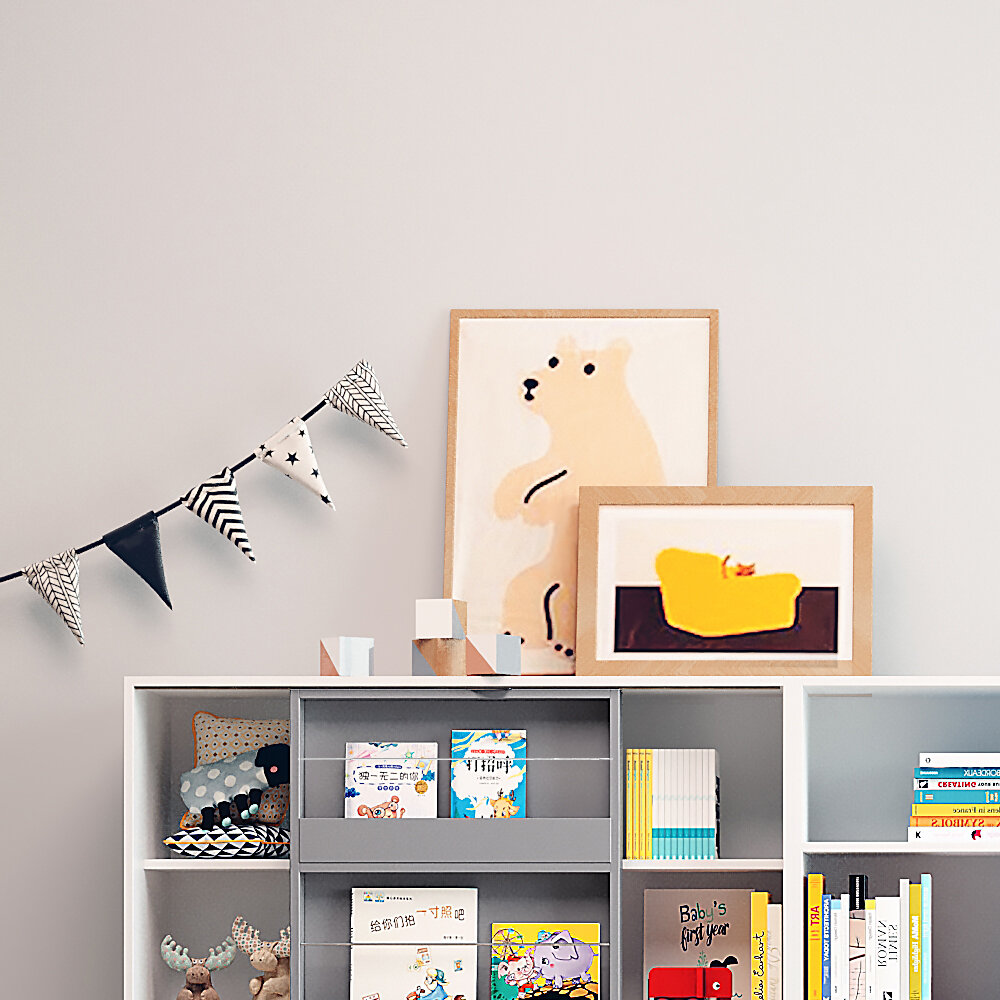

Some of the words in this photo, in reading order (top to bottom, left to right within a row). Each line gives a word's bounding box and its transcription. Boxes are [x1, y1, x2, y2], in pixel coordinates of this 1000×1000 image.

[358, 770, 419, 782] 独一无二的你
[370, 905, 466, 934] 给你们拍一寸照吧
[680, 901, 727, 923] Baby's
[680, 923, 705, 952] first
[705, 922, 730, 947] year
